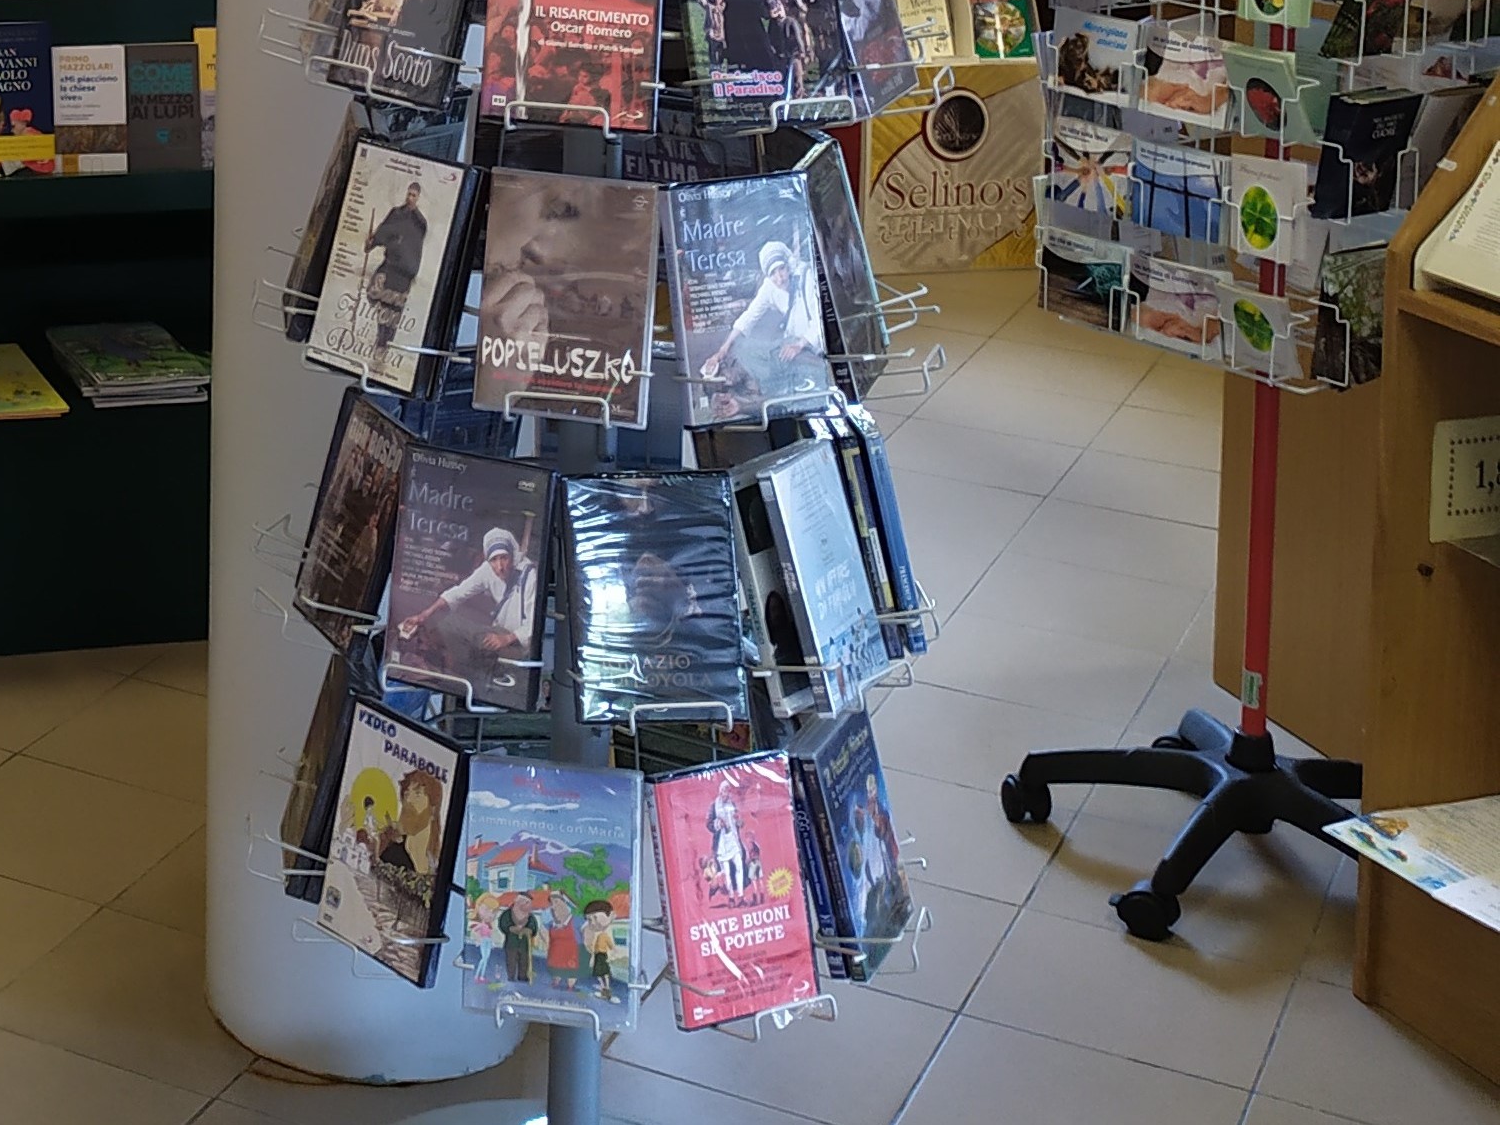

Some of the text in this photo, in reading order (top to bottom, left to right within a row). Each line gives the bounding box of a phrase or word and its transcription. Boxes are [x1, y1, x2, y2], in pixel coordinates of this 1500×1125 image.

[535, 5, 649, 26] IL RISARCIMENTO
[550, 21, 632, 39] Oscar Romero
[59, 55, 90, 64] PRIMO
[59, 62, 113, 71] MAZZOLARI
[338, 29, 432, 88] Duns Scoto
[80, 75, 118, 84] piacciono
[725, 83, 784, 96] Paradiso
[131, 95, 193, 105] IN MEZZO
[132, 105, 194, 119] AI LUPI
[883, 170, 1028, 211] Selino's
[682, 217, 744, 243] Madre
[685, 249, 746, 272] Teresa
[335, 291, 417, 333] Antonio
[356, 323, 370, 338] di
[326, 327, 405, 370] Padova
[412, 452, 437, 466] Olivia
[409, 481, 475, 513] Madre
[408, 509, 469, 542] Teresa
[358, 709, 397, 739] VIDEO
[383, 741, 449, 784] PARABOLE
[471, 814, 626, 840] Camminando con Maria
[690, 904, 792, 941] STATE BUONI
[726, 925, 785, 952] POTETE
